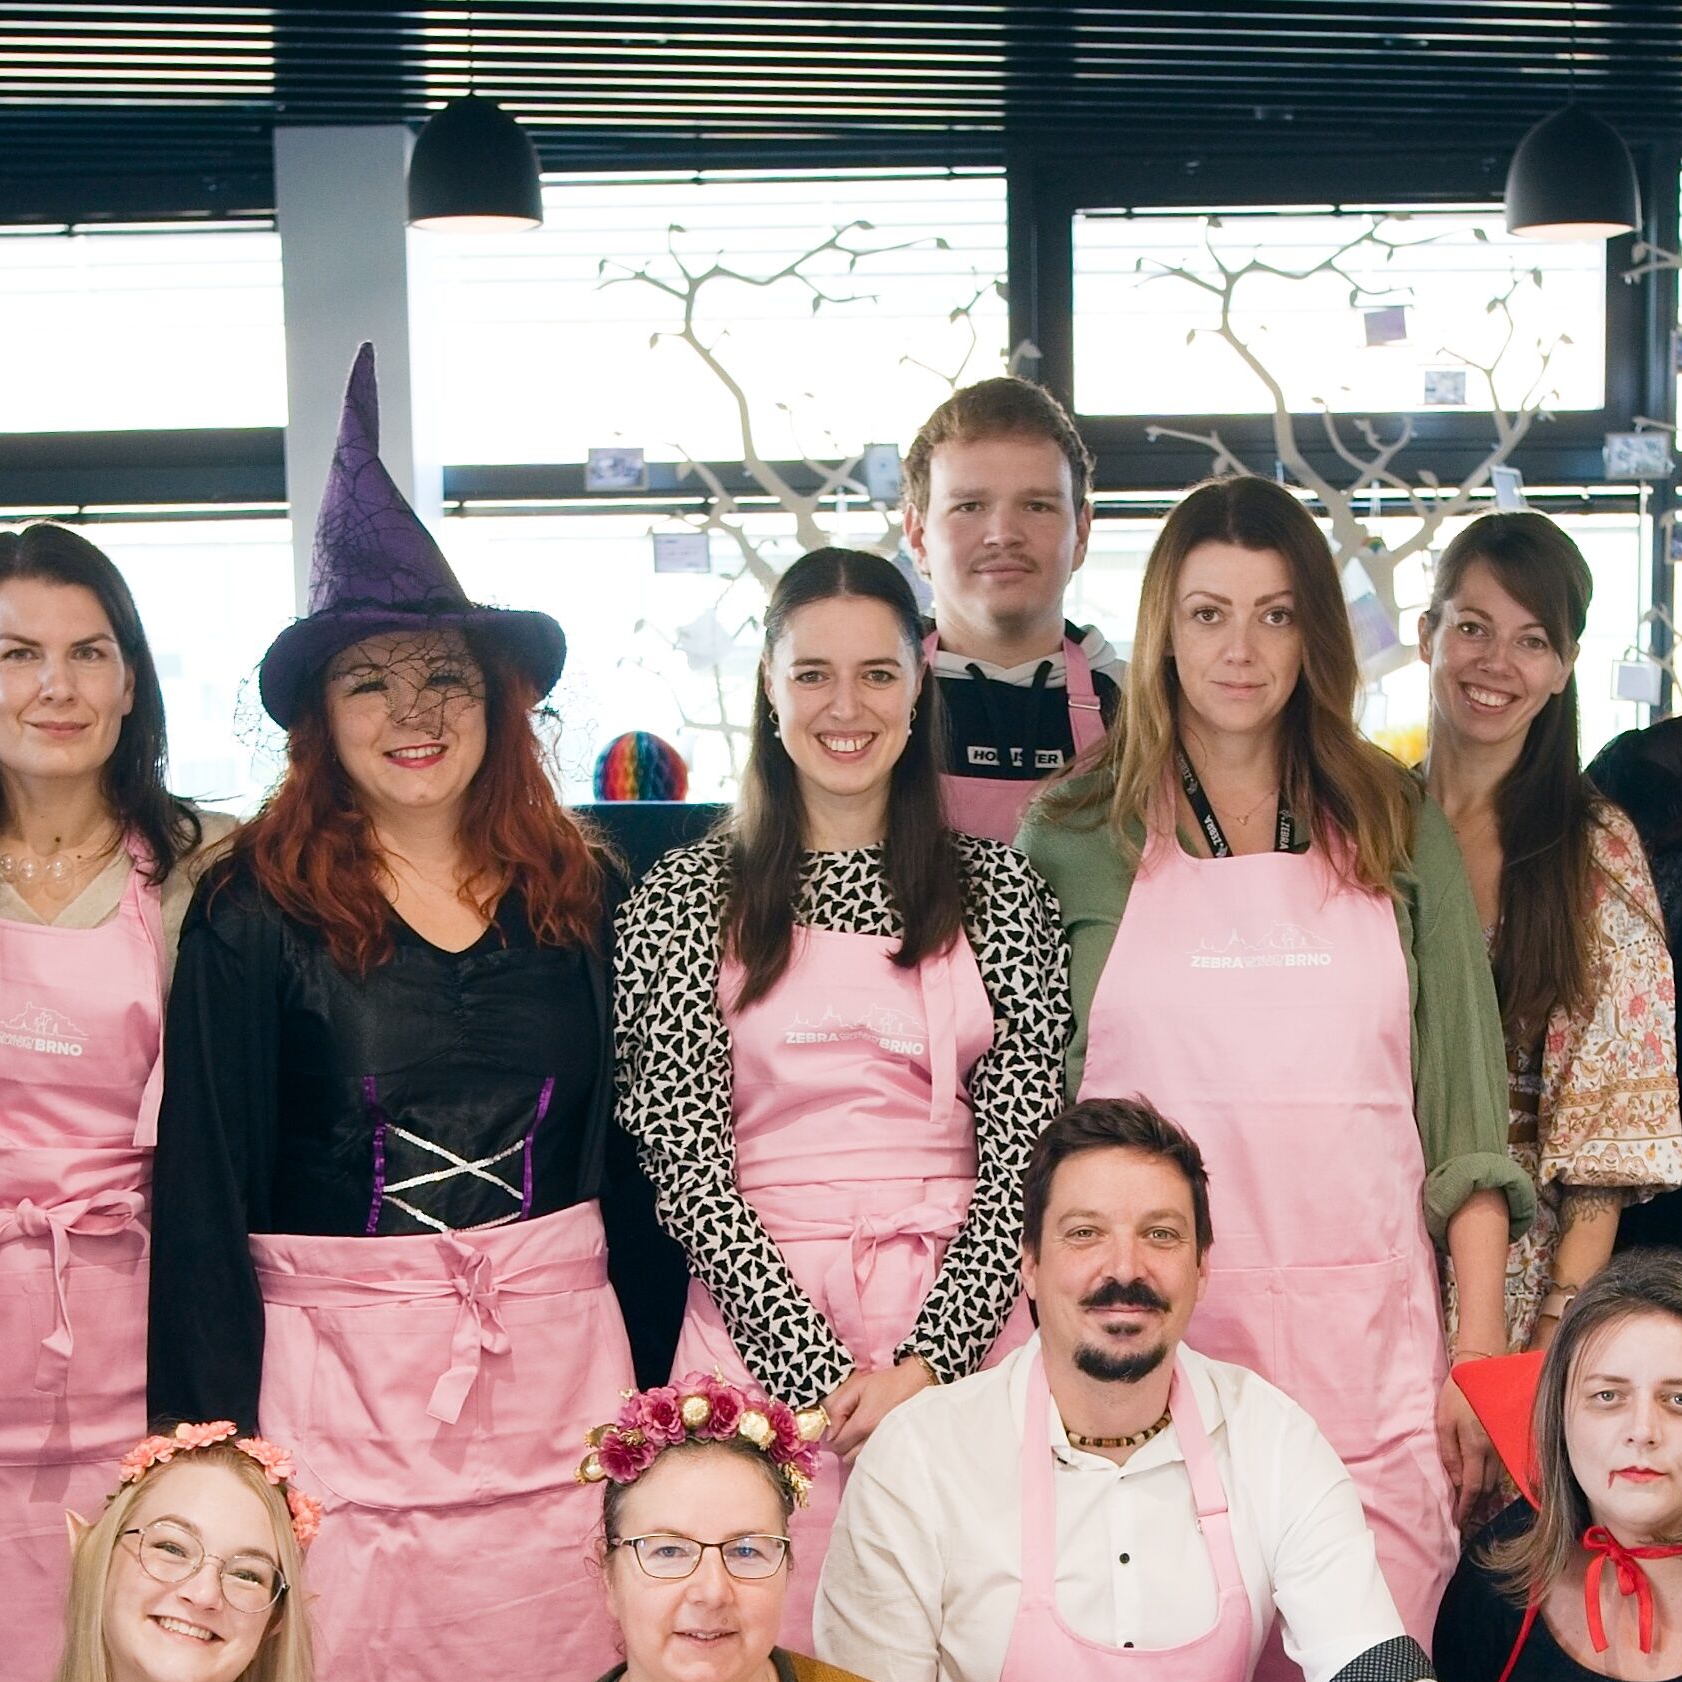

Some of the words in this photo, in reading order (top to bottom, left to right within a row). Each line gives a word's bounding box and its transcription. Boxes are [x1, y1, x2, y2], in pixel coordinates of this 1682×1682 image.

[1204, 814, 1222, 846] ZEBRA
[1279, 821, 1290, 850] ZEBRA
[1190, 955, 1244, 968] ZEBRA
[1285, 953, 1331, 966] BRNO
[34, 1038, 83, 1056] BRNO
[785, 1031, 839, 1044] ZEBRA
[879, 1038, 924, 1055] BRNO
